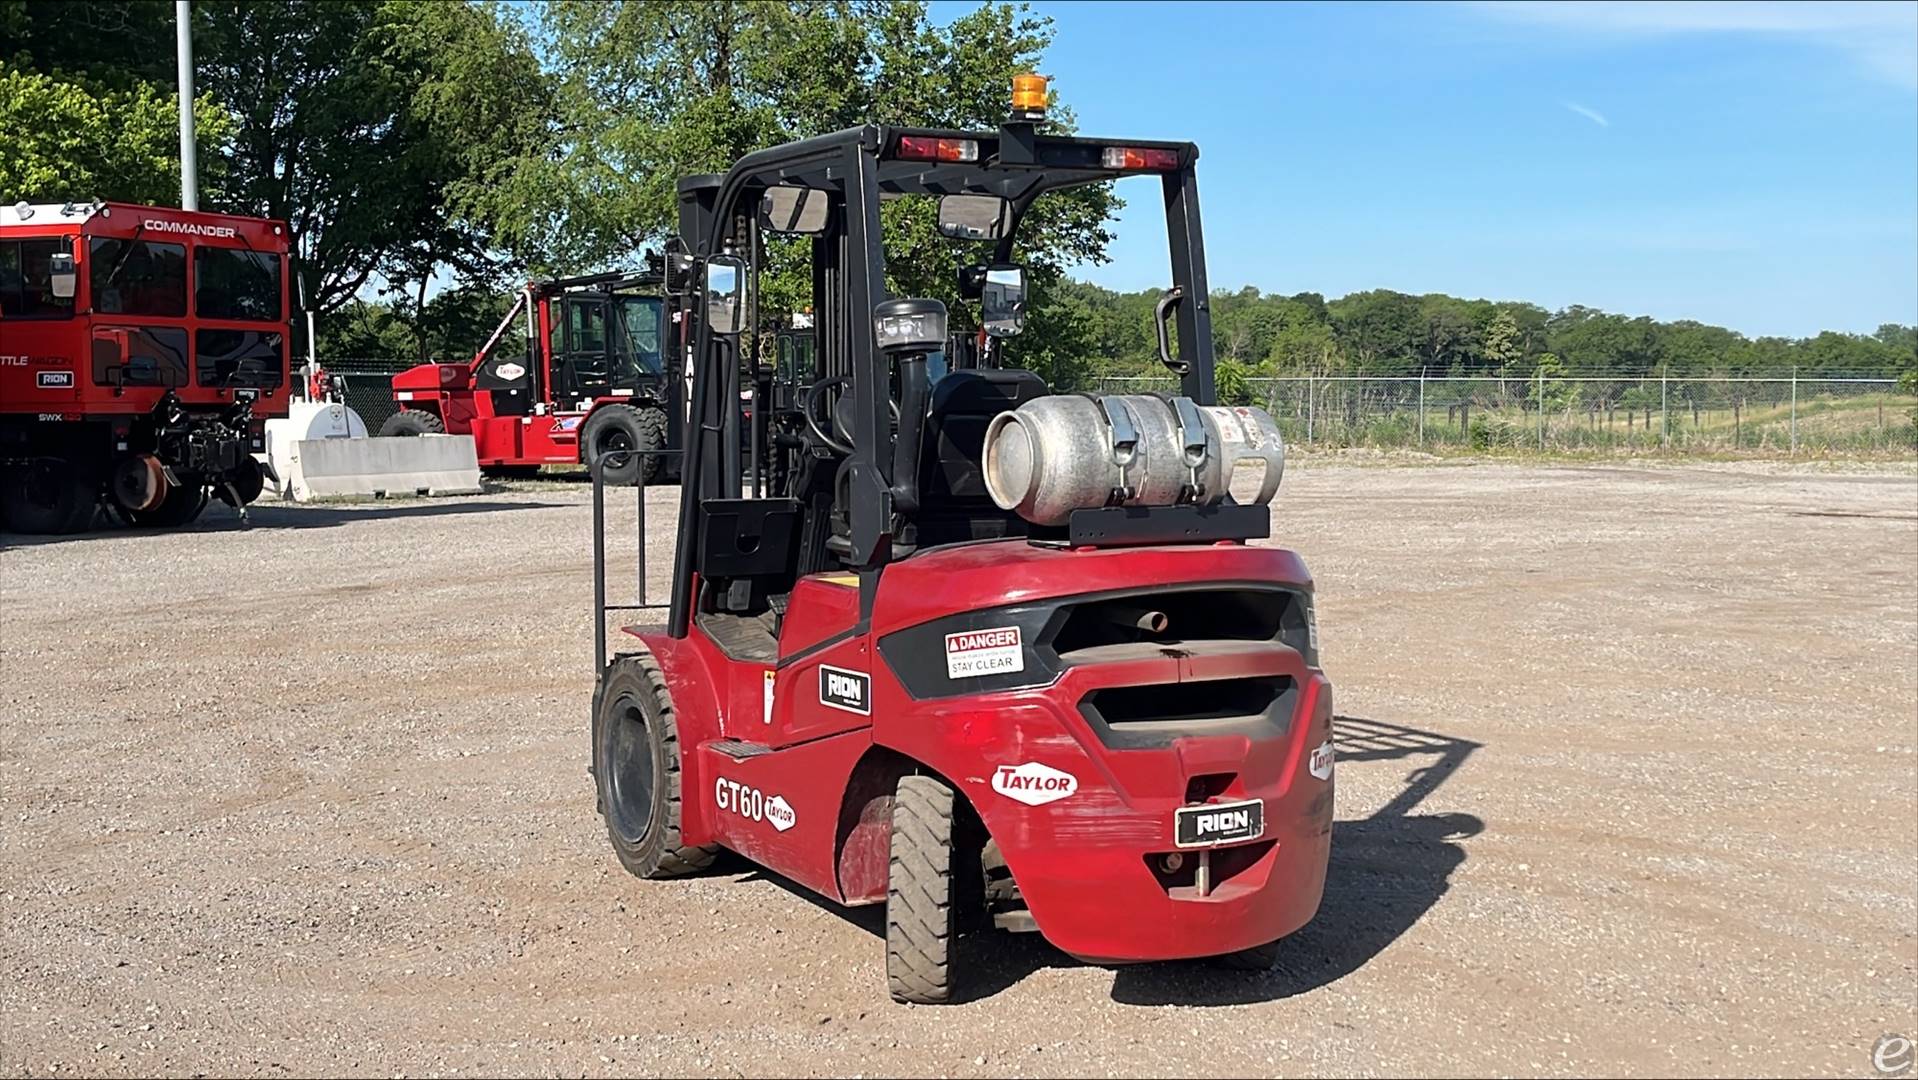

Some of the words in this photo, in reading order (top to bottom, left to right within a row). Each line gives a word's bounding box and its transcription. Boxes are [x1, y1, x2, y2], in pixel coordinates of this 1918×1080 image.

[144, 219, 235, 238] COMMANDER
[42, 374, 68, 384] RION
[959, 631, 1017, 650] DANGER
[952, 662, 973, 673] STAY
[975, 657, 1013, 670] CLEAR
[828, 673, 861, 700] RION
[1000, 768, 1071, 791] TAYLOR
[715, 777, 763, 822] GT60
[767, 799, 792, 823] TAYLOR
[1197, 810, 1248, 836] RION
